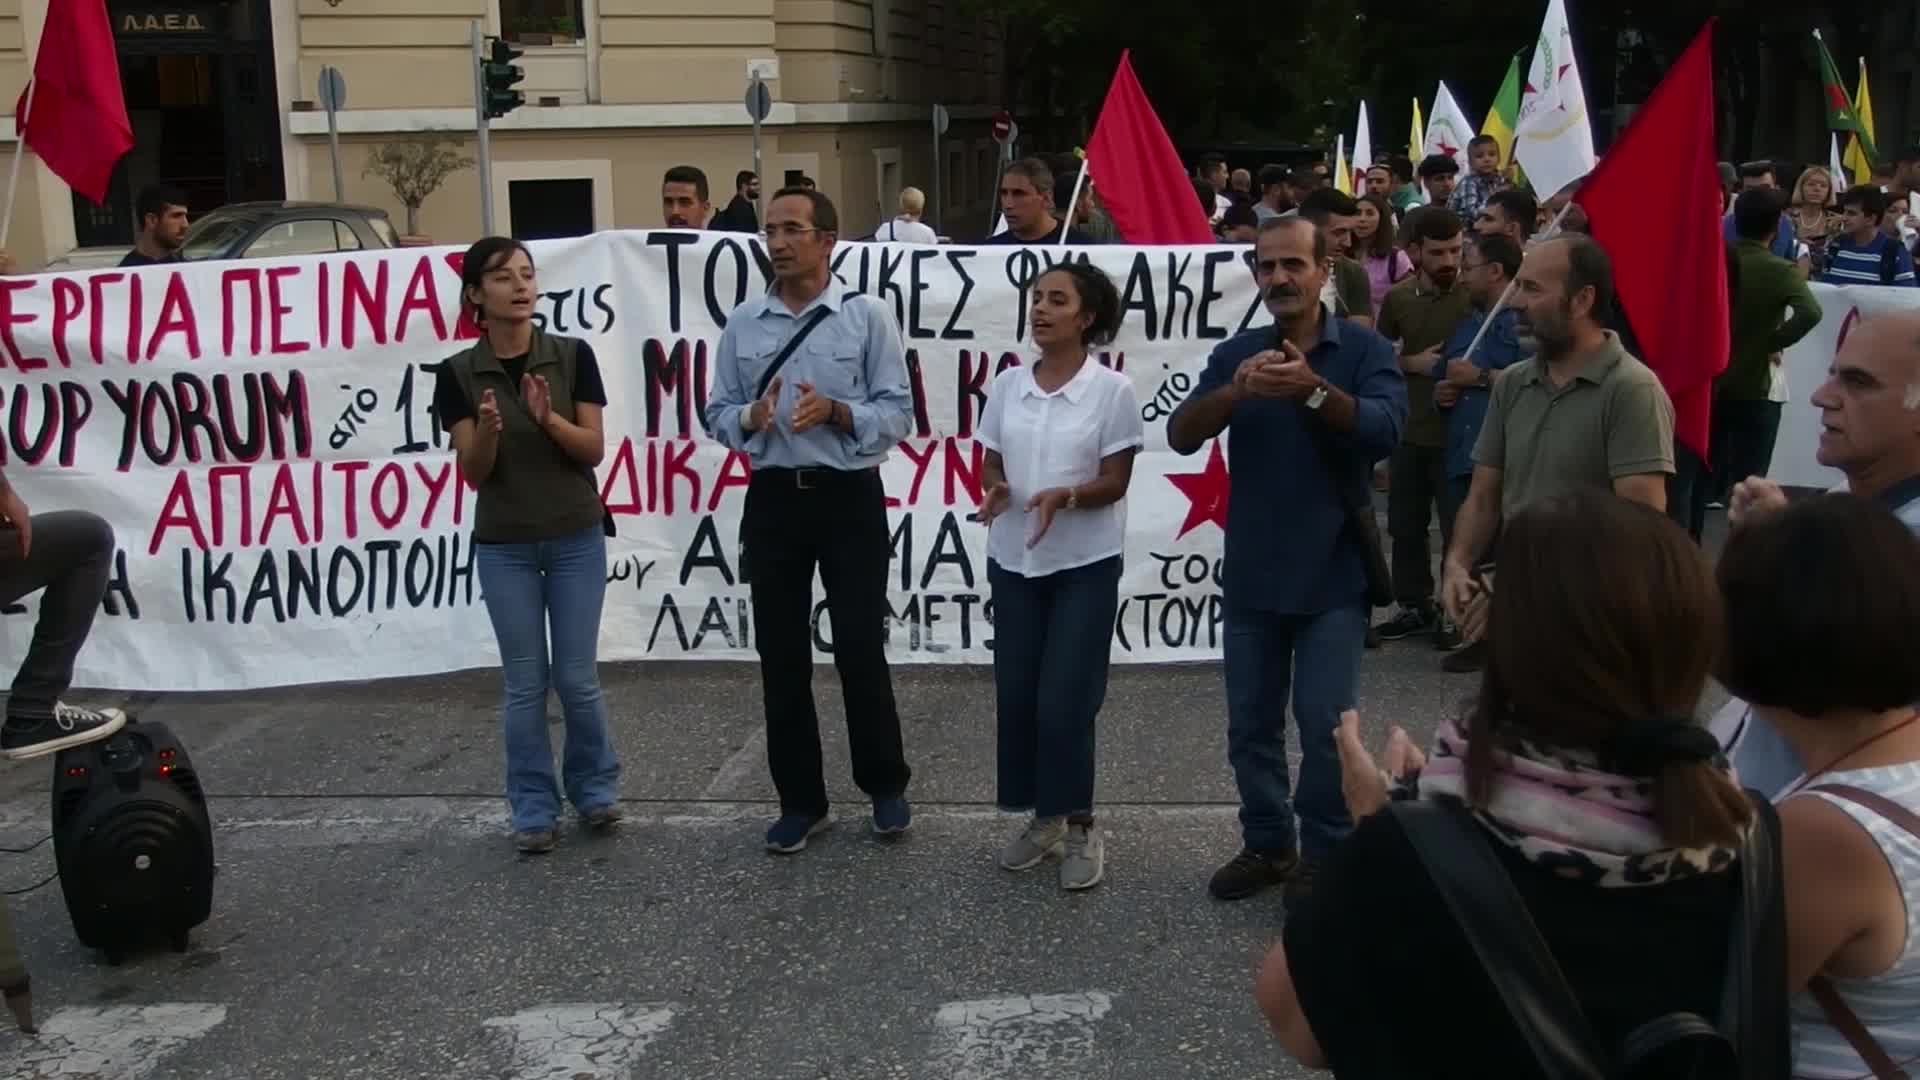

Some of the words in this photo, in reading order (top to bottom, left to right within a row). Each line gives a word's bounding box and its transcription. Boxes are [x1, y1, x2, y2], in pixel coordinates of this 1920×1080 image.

[0, 271, 201, 374] ΕΡΓΙΑ
[0, 381, 93, 468] UP
[101, 369, 313, 473] YORUM
